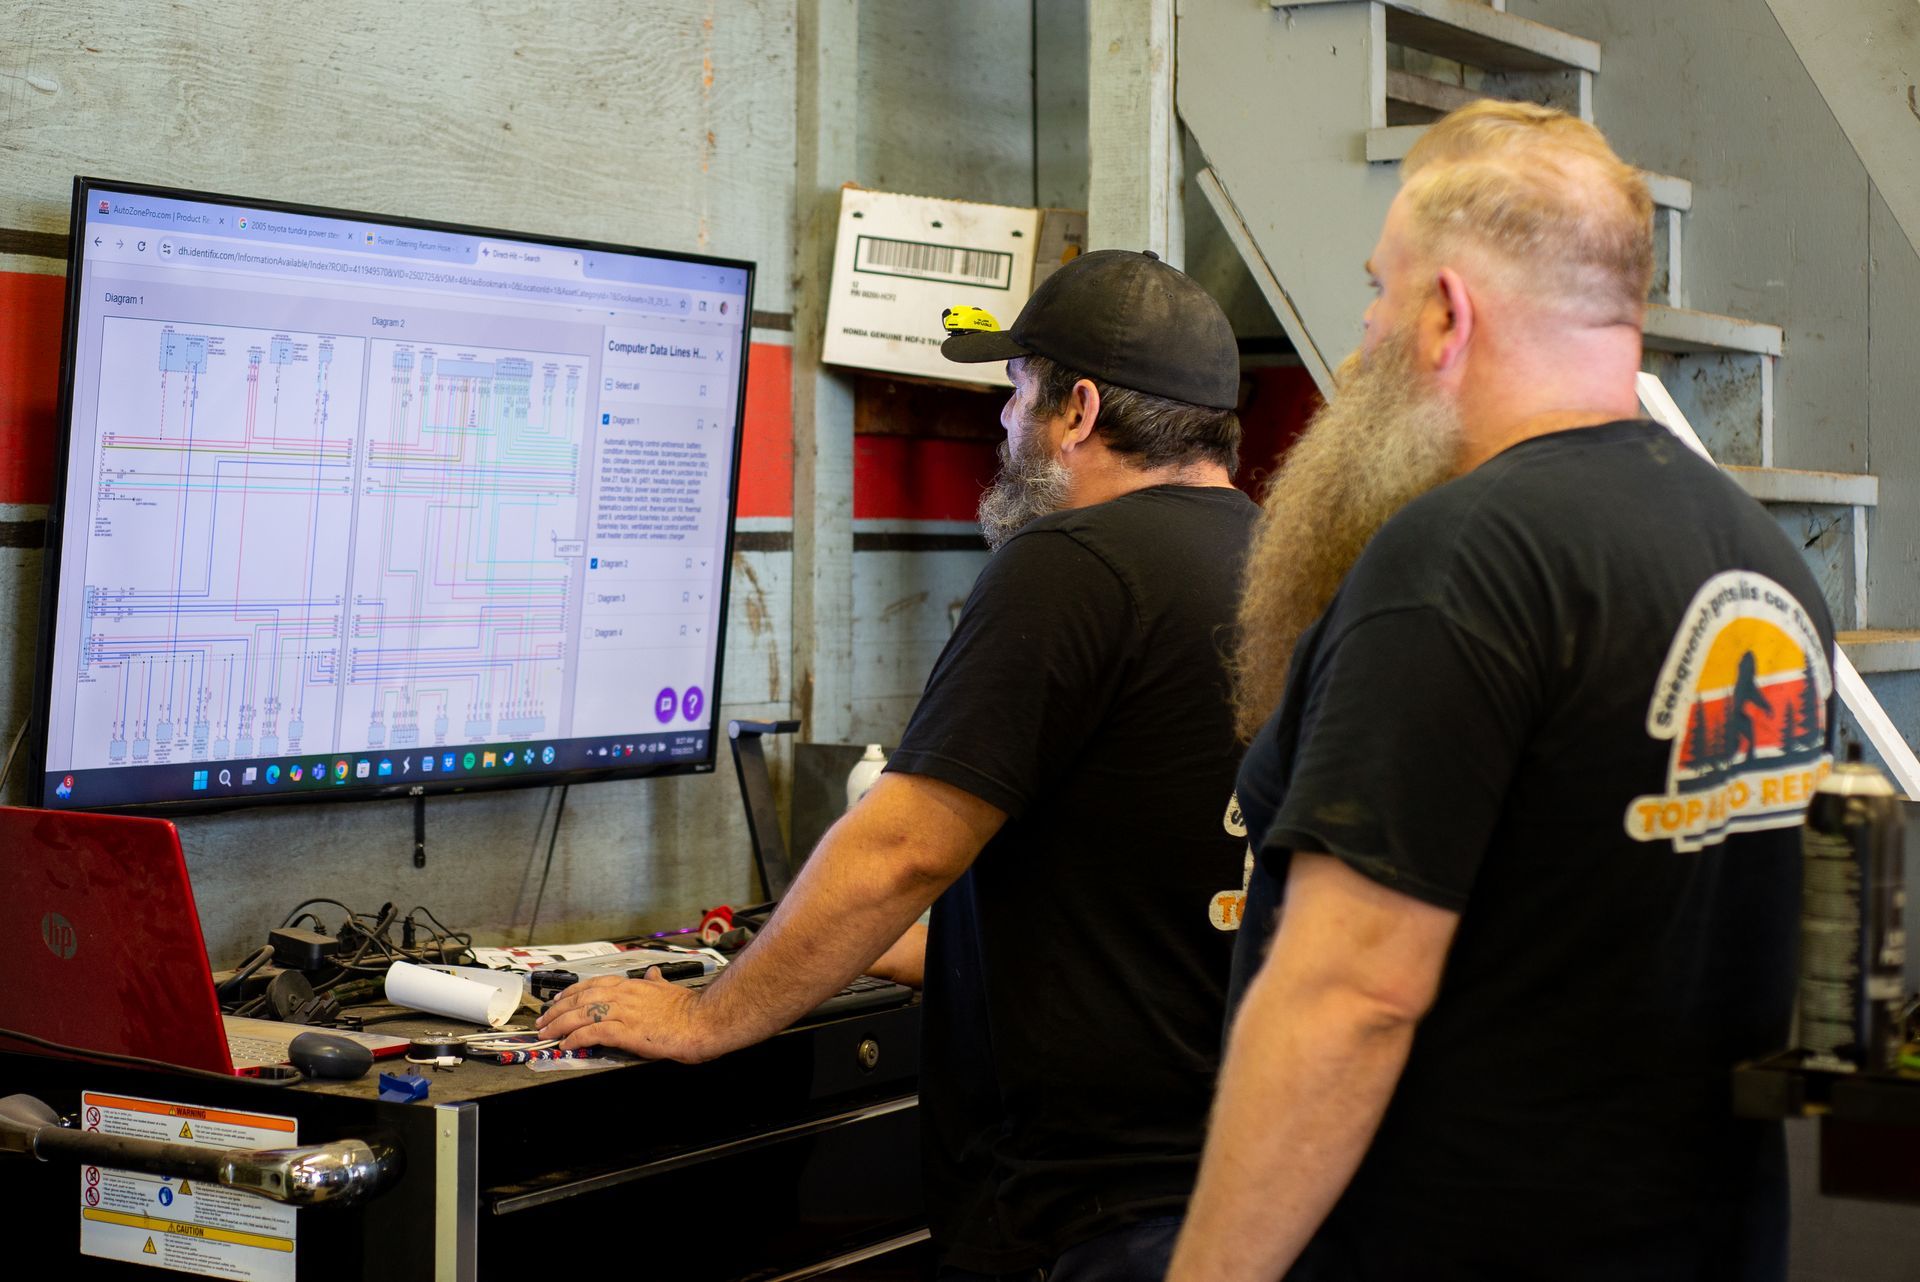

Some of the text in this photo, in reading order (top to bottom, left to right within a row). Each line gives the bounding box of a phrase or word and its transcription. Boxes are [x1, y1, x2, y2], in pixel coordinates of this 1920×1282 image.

[114, 205, 172, 220] AutoZonePro.com
[176, 212, 201, 224] Product
[251, 221, 267, 231] 2005
[268, 224, 287, 235] toyota
[288, 226, 307, 236] tundra
[105, 292, 138, 306] Diagram
[372, 316, 399, 328] Diagram
[843, 327, 868, 337] HONDA
[870, 331, 902, 341] GENUINE
[608, 340, 649, 356] Computer
[650, 343, 668, 356] Data
[670, 345, 691, 358] Lines
[1637, 800, 1703, 832] TOP
[176, 1107, 207, 1120] WARNING
[176, 1224, 205, 1237] CAUTION
